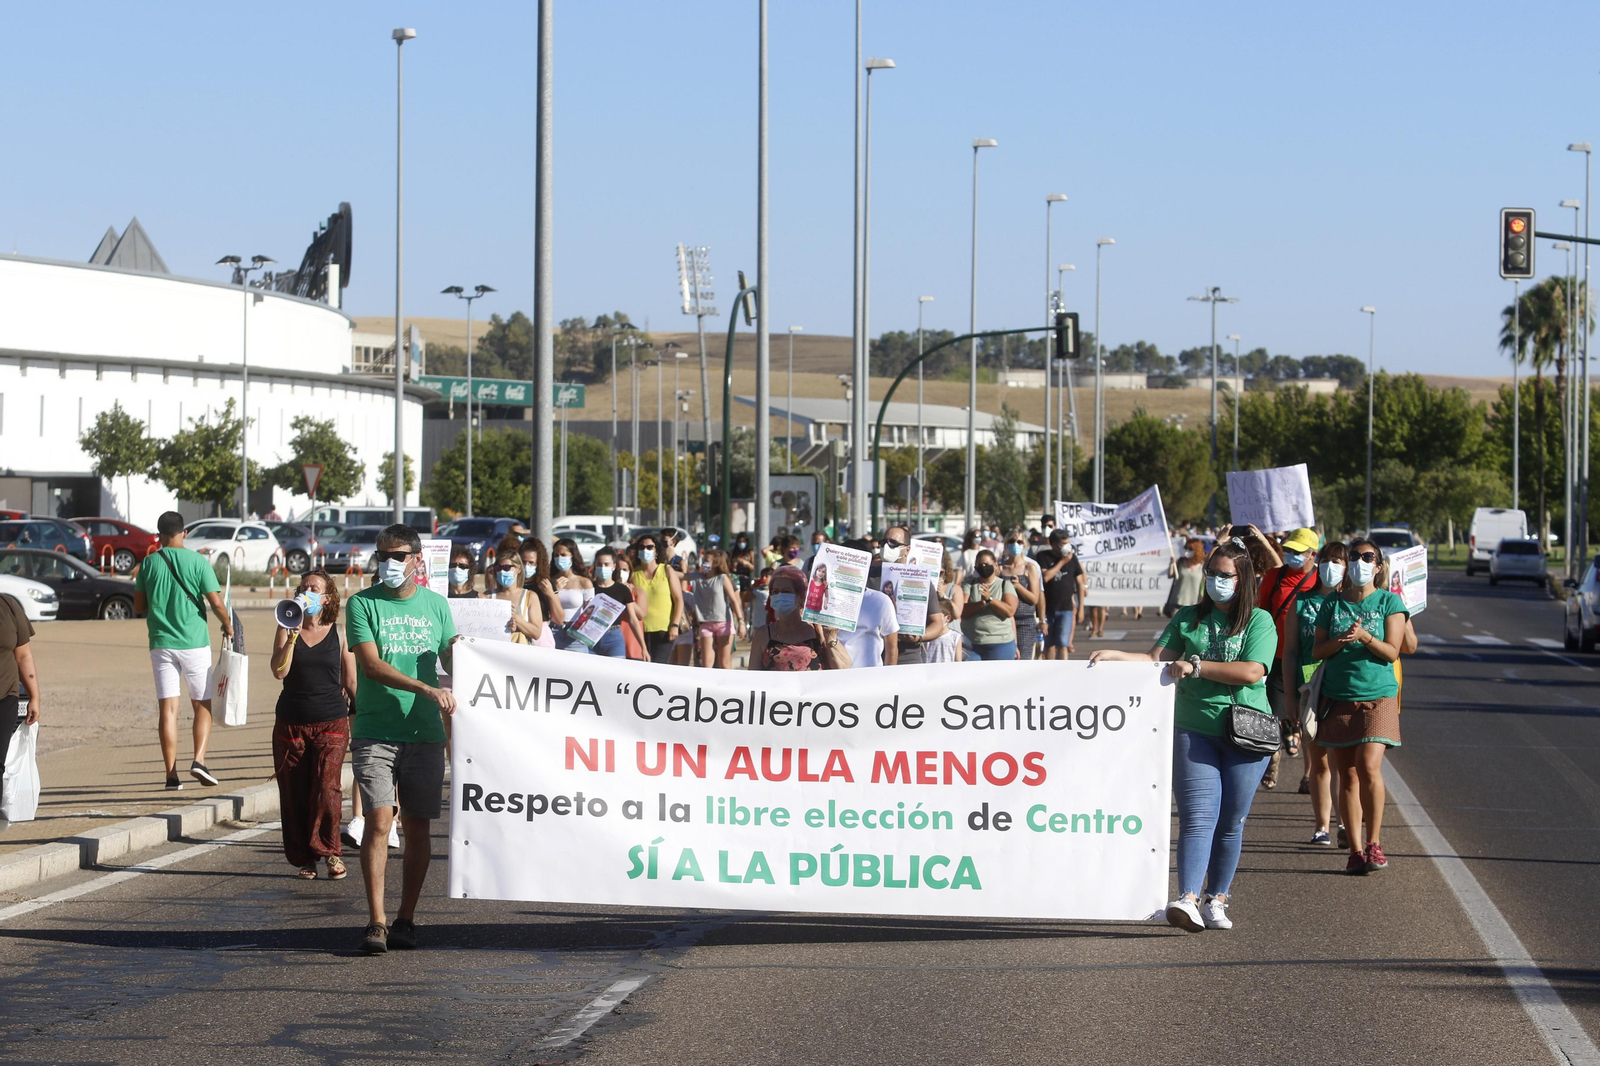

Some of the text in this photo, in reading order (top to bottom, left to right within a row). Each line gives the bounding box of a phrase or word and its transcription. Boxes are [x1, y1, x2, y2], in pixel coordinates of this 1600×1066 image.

[1231, 475, 1263, 494] NO
[1062, 504, 1082, 518] POR
[1095, 535, 1136, 555] CALIDAD
[1086, 560, 1146, 574] GIR MI COLE
[1095, 577, 1106, 589] AL
[1111, 577, 1143, 590] CIERRE
[1149, 577, 1161, 590] DE
[457, 607, 508, 618] MANTENER LAS
[472, 673, 1142, 740] AMPA “Caballeros de Santiago”
[564, 736, 1047, 787] NI UN AULA MENOS
[461, 783, 1143, 835] Respeto a la libre elección de Centro
[626, 836, 982, 891] SÍ A LA PÚBLICA
